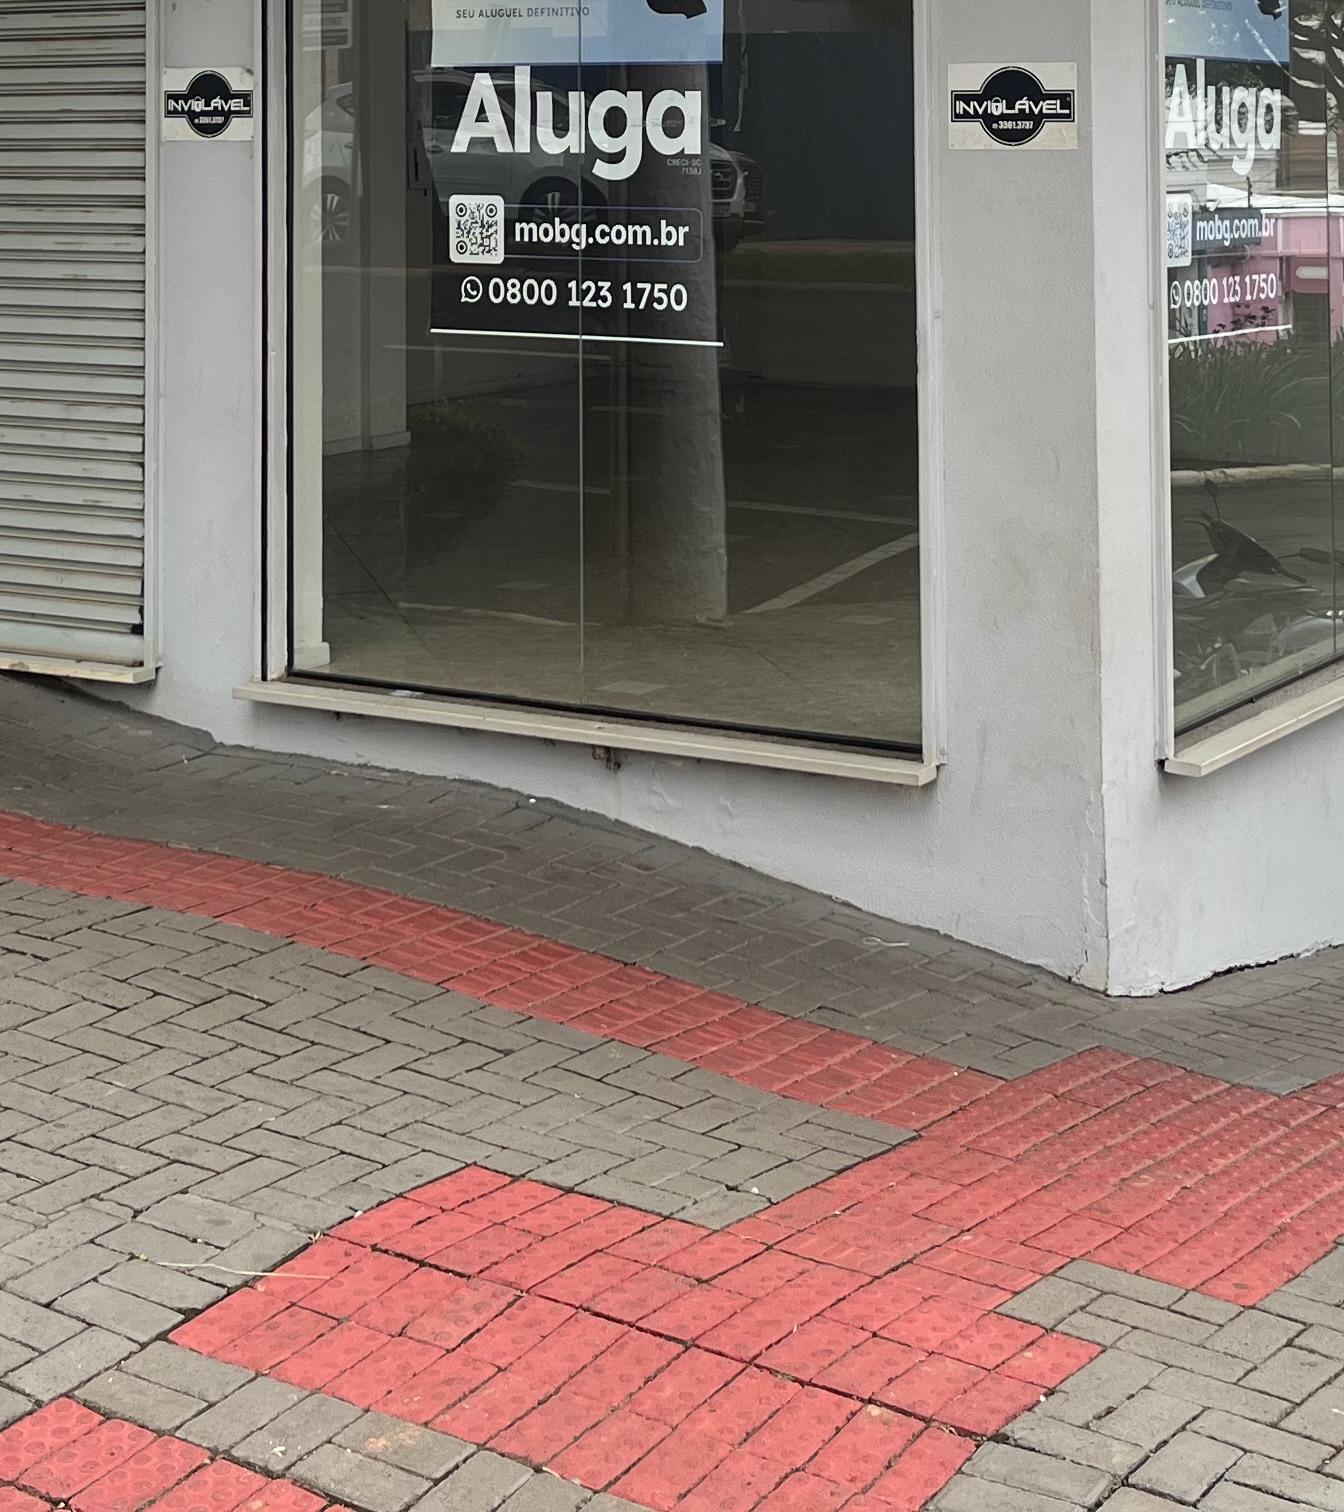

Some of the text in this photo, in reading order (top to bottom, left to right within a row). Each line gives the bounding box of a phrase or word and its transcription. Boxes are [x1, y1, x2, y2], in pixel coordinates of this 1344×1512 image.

[455, 6, 591, 19] SEU ALUGUEL DEFINITIVO
[167, 95, 251, 113] INVIOLÁVEL
[956, 96, 1070, 116] INVIOLÁVEL
[1165, 57, 1282, 176] Aluga
[450, 65, 703, 181] Aluga
[513, 217, 690, 251] mobg.com.br
[1196, 214, 1276, 247] mobg.com.br
[487, 275, 689, 312] 0800 123 1750
[1184, 273, 1277, 308] 0800 123 1750
